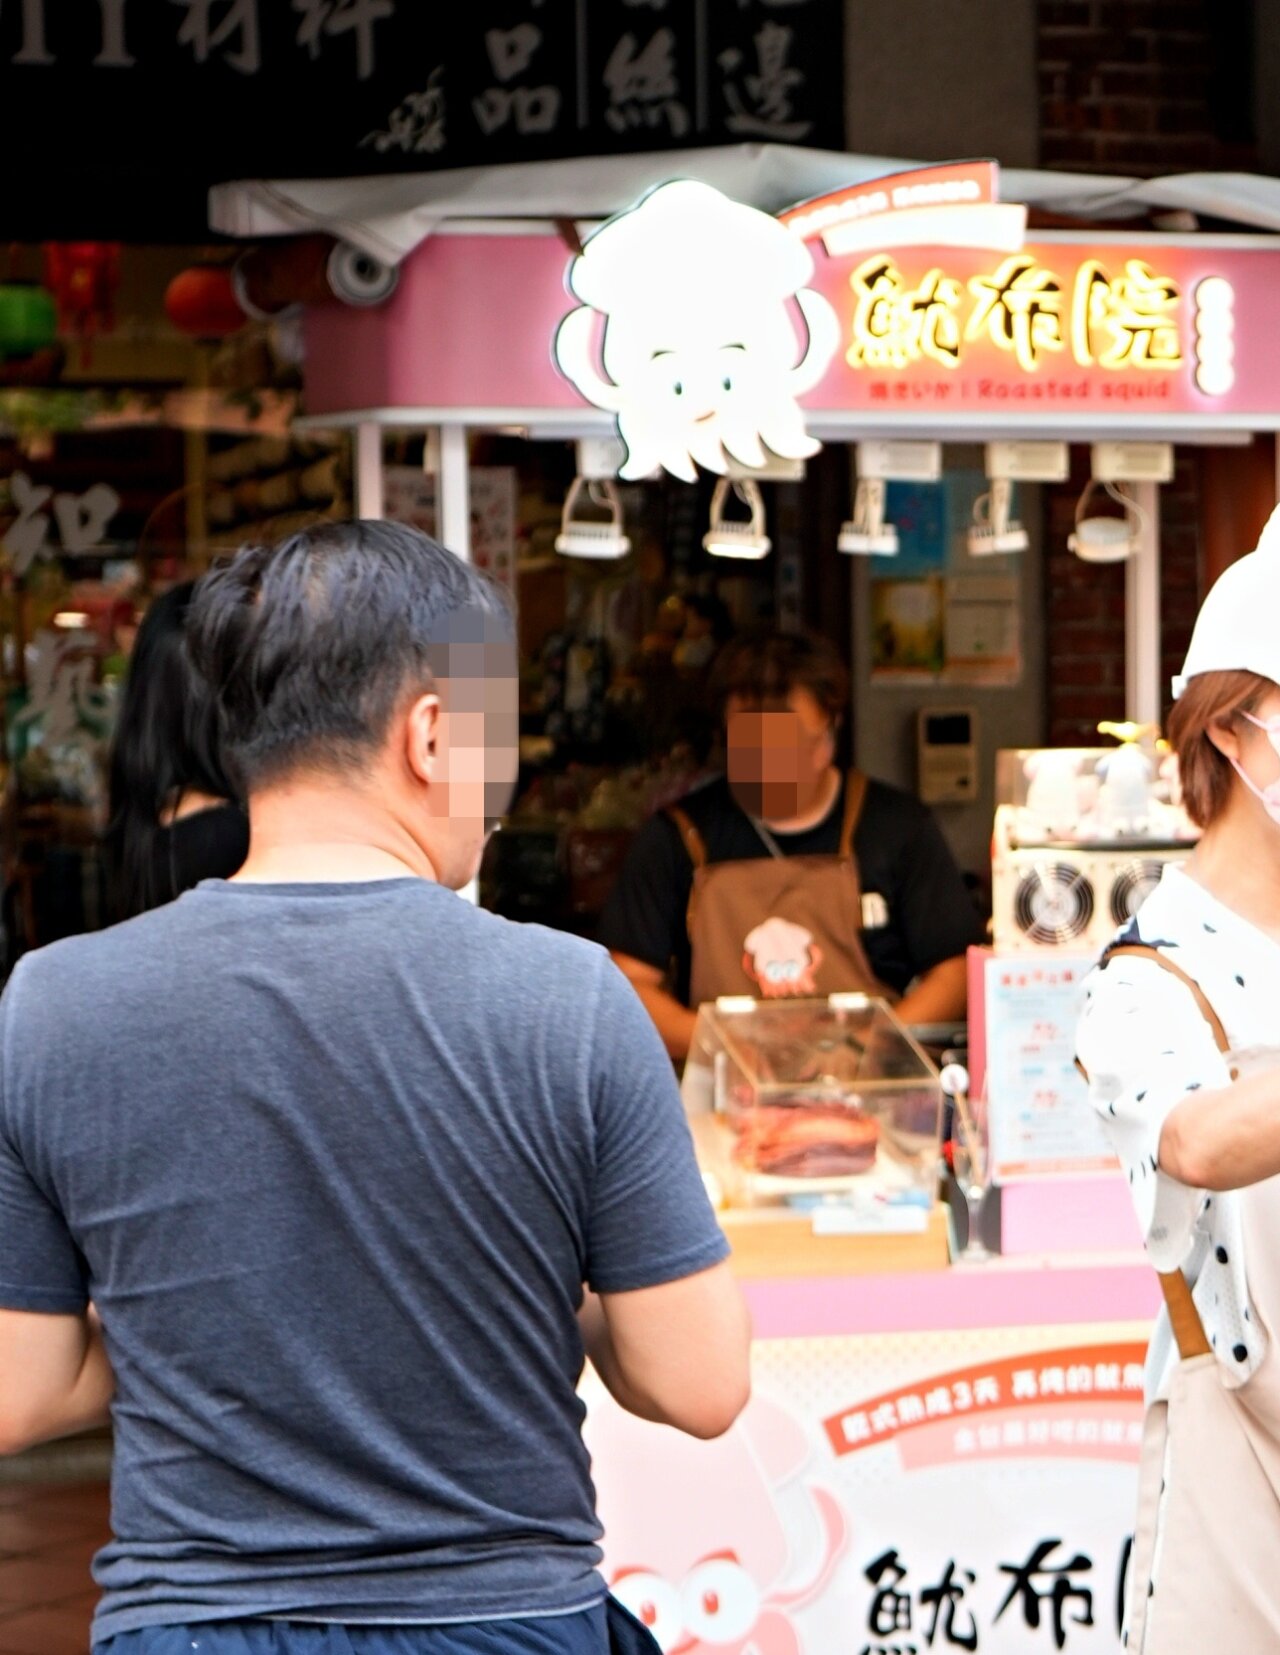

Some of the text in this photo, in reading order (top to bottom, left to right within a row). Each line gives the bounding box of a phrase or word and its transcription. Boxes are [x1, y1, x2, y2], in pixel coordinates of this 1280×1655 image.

[846, 255, 1183, 371] 魷布院
[979, 379, 1169, 401] Roasted squid
[862, 1537, 1133, 1655] 魷布
